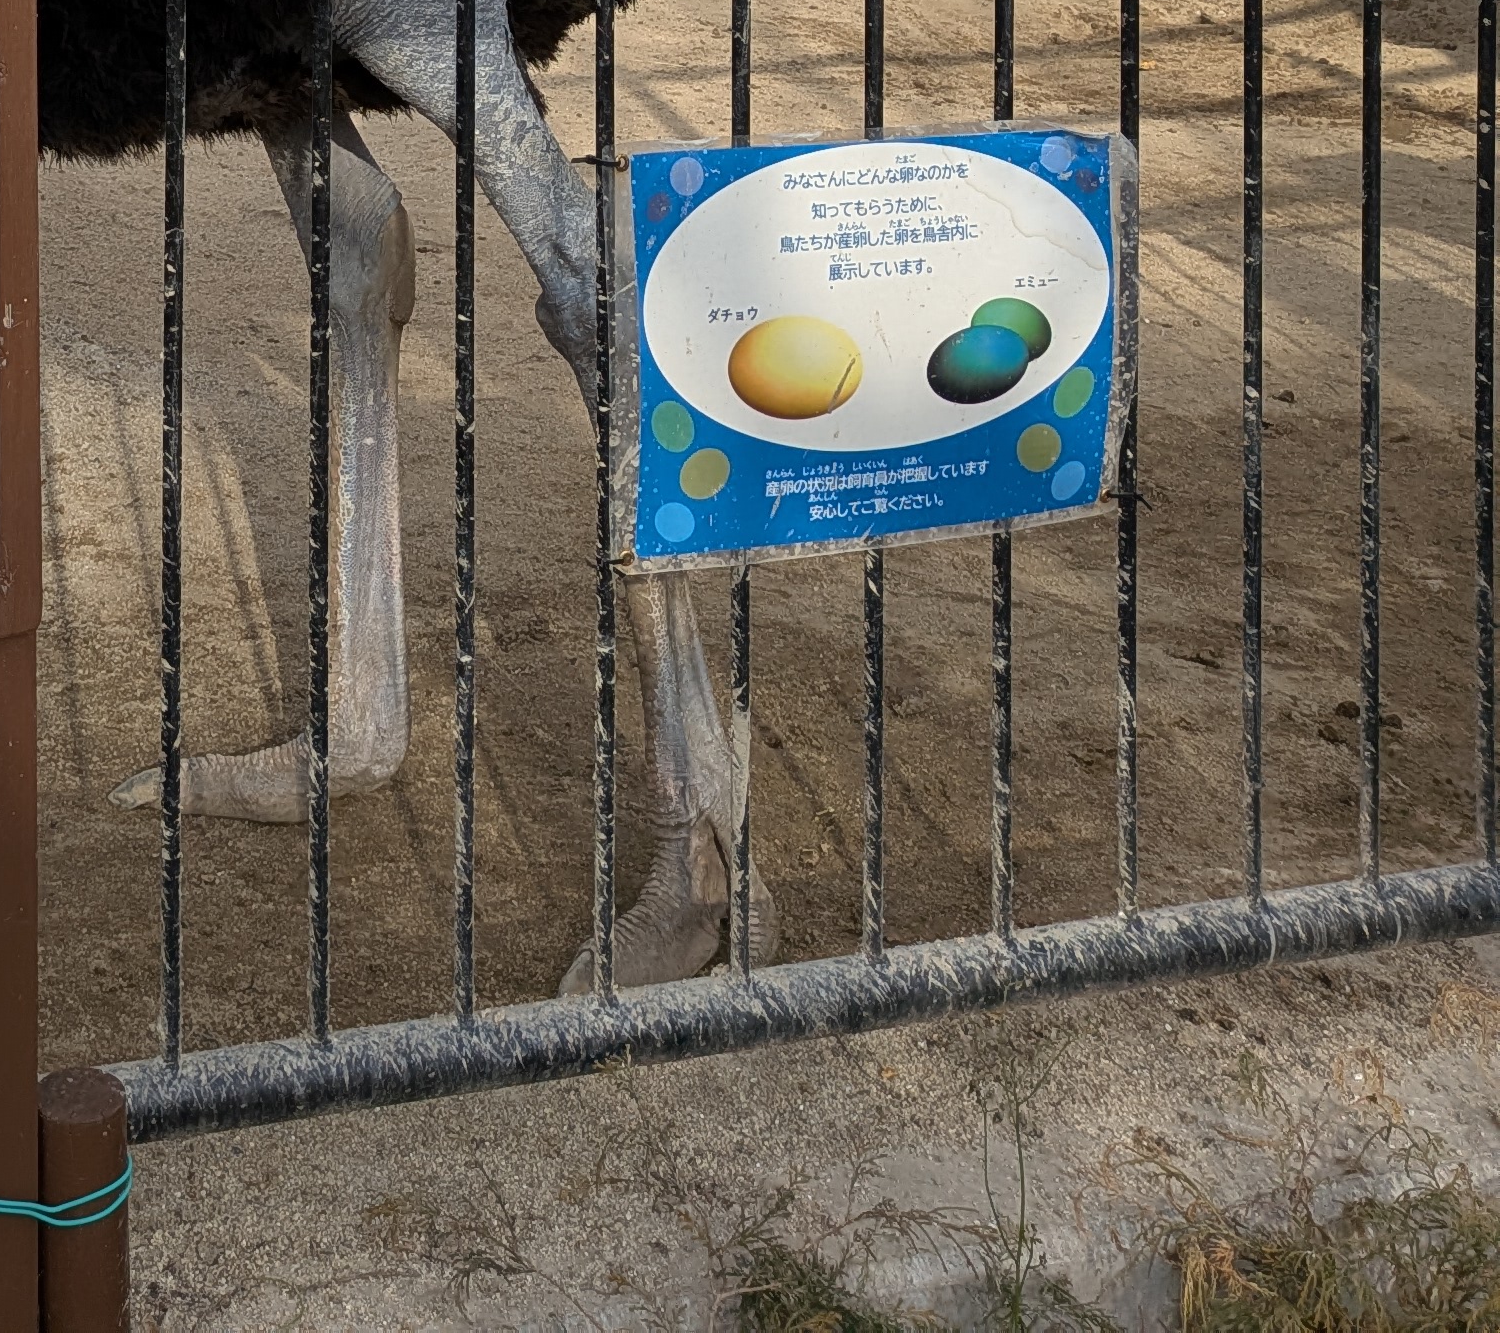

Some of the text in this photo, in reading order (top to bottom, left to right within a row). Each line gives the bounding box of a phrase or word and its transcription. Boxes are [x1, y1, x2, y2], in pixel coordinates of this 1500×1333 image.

[895, 154, 916, 164] たまご
[783, 162, 969, 190] みなさんにどんな卵なのかを
[811, 196, 943, 220] 知ってもらうために、
[837, 221, 867, 232] さんらん
[889, 217, 911, 228] たまご
[779, 224, 979, 254] 鳥たちが産卵した卵を鳥舎内に
[828, 258, 933, 282] 展示しています。
[830, 253, 851, 263] てんじ
[1015, 277, 1059, 288] エミュー
[707, 306, 759, 323] ダチョウ
[765, 460, 990, 497] 産卵の状況は飼育員が把握しています
[809, 494, 944, 521] 安心してご覧ください。
